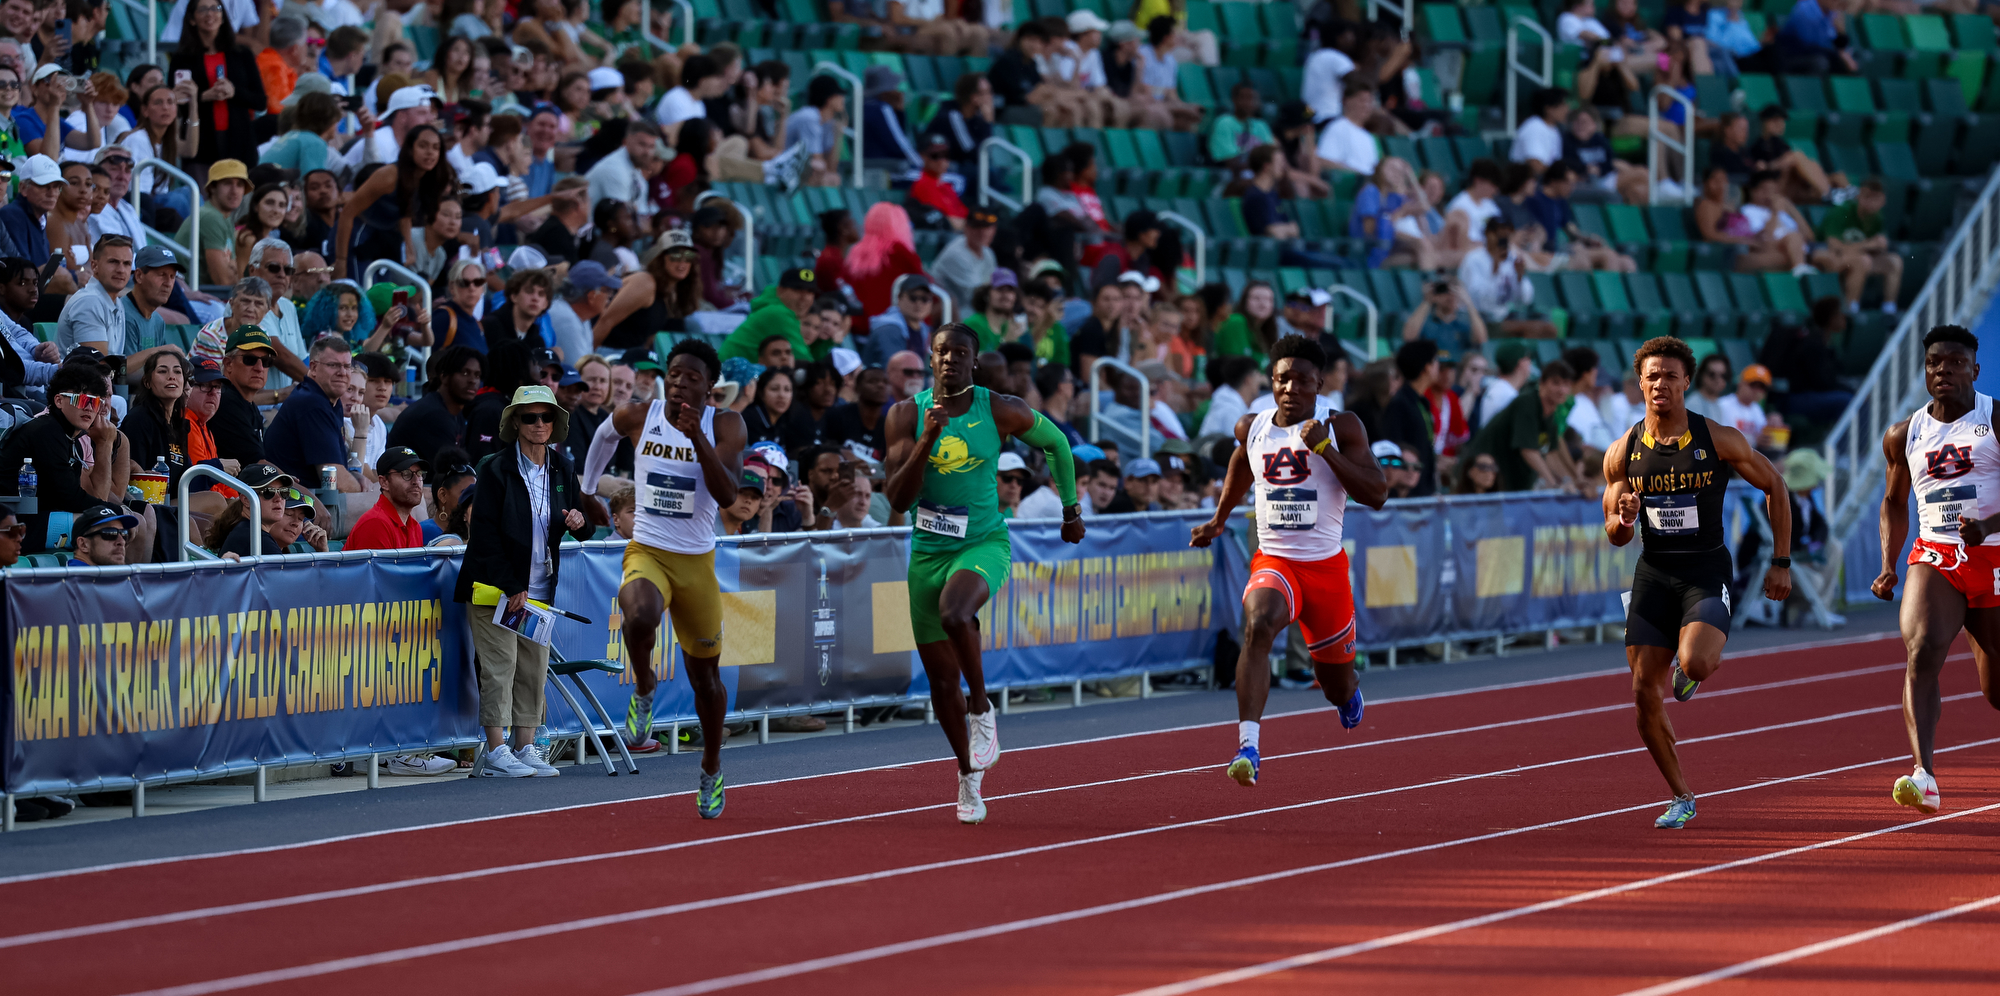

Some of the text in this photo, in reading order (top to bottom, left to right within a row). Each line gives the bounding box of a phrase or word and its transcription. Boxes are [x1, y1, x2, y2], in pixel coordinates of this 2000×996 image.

[1975, 424, 1989, 437] SEC
[641, 441, 698, 463] HORNE
[653, 489, 685, 500] JAMARION
[653, 498, 683, 510] STUBBS
[1272, 503, 1311, 512] KANYINSOLA
[1938, 503, 1963, 512] FAVOUR
[1280, 513, 1302, 522] AJAYI
[1656, 510, 1685, 518] MALACHI
[922, 518, 960, 534] IZE-IYAMU
[1660, 518, 1684, 527] SNOW
[1927, 551, 1938, 563] 5
[14, 599, 442, 741] NCAA DI TRACK AND FIELD CHAMPIONSHIPS
